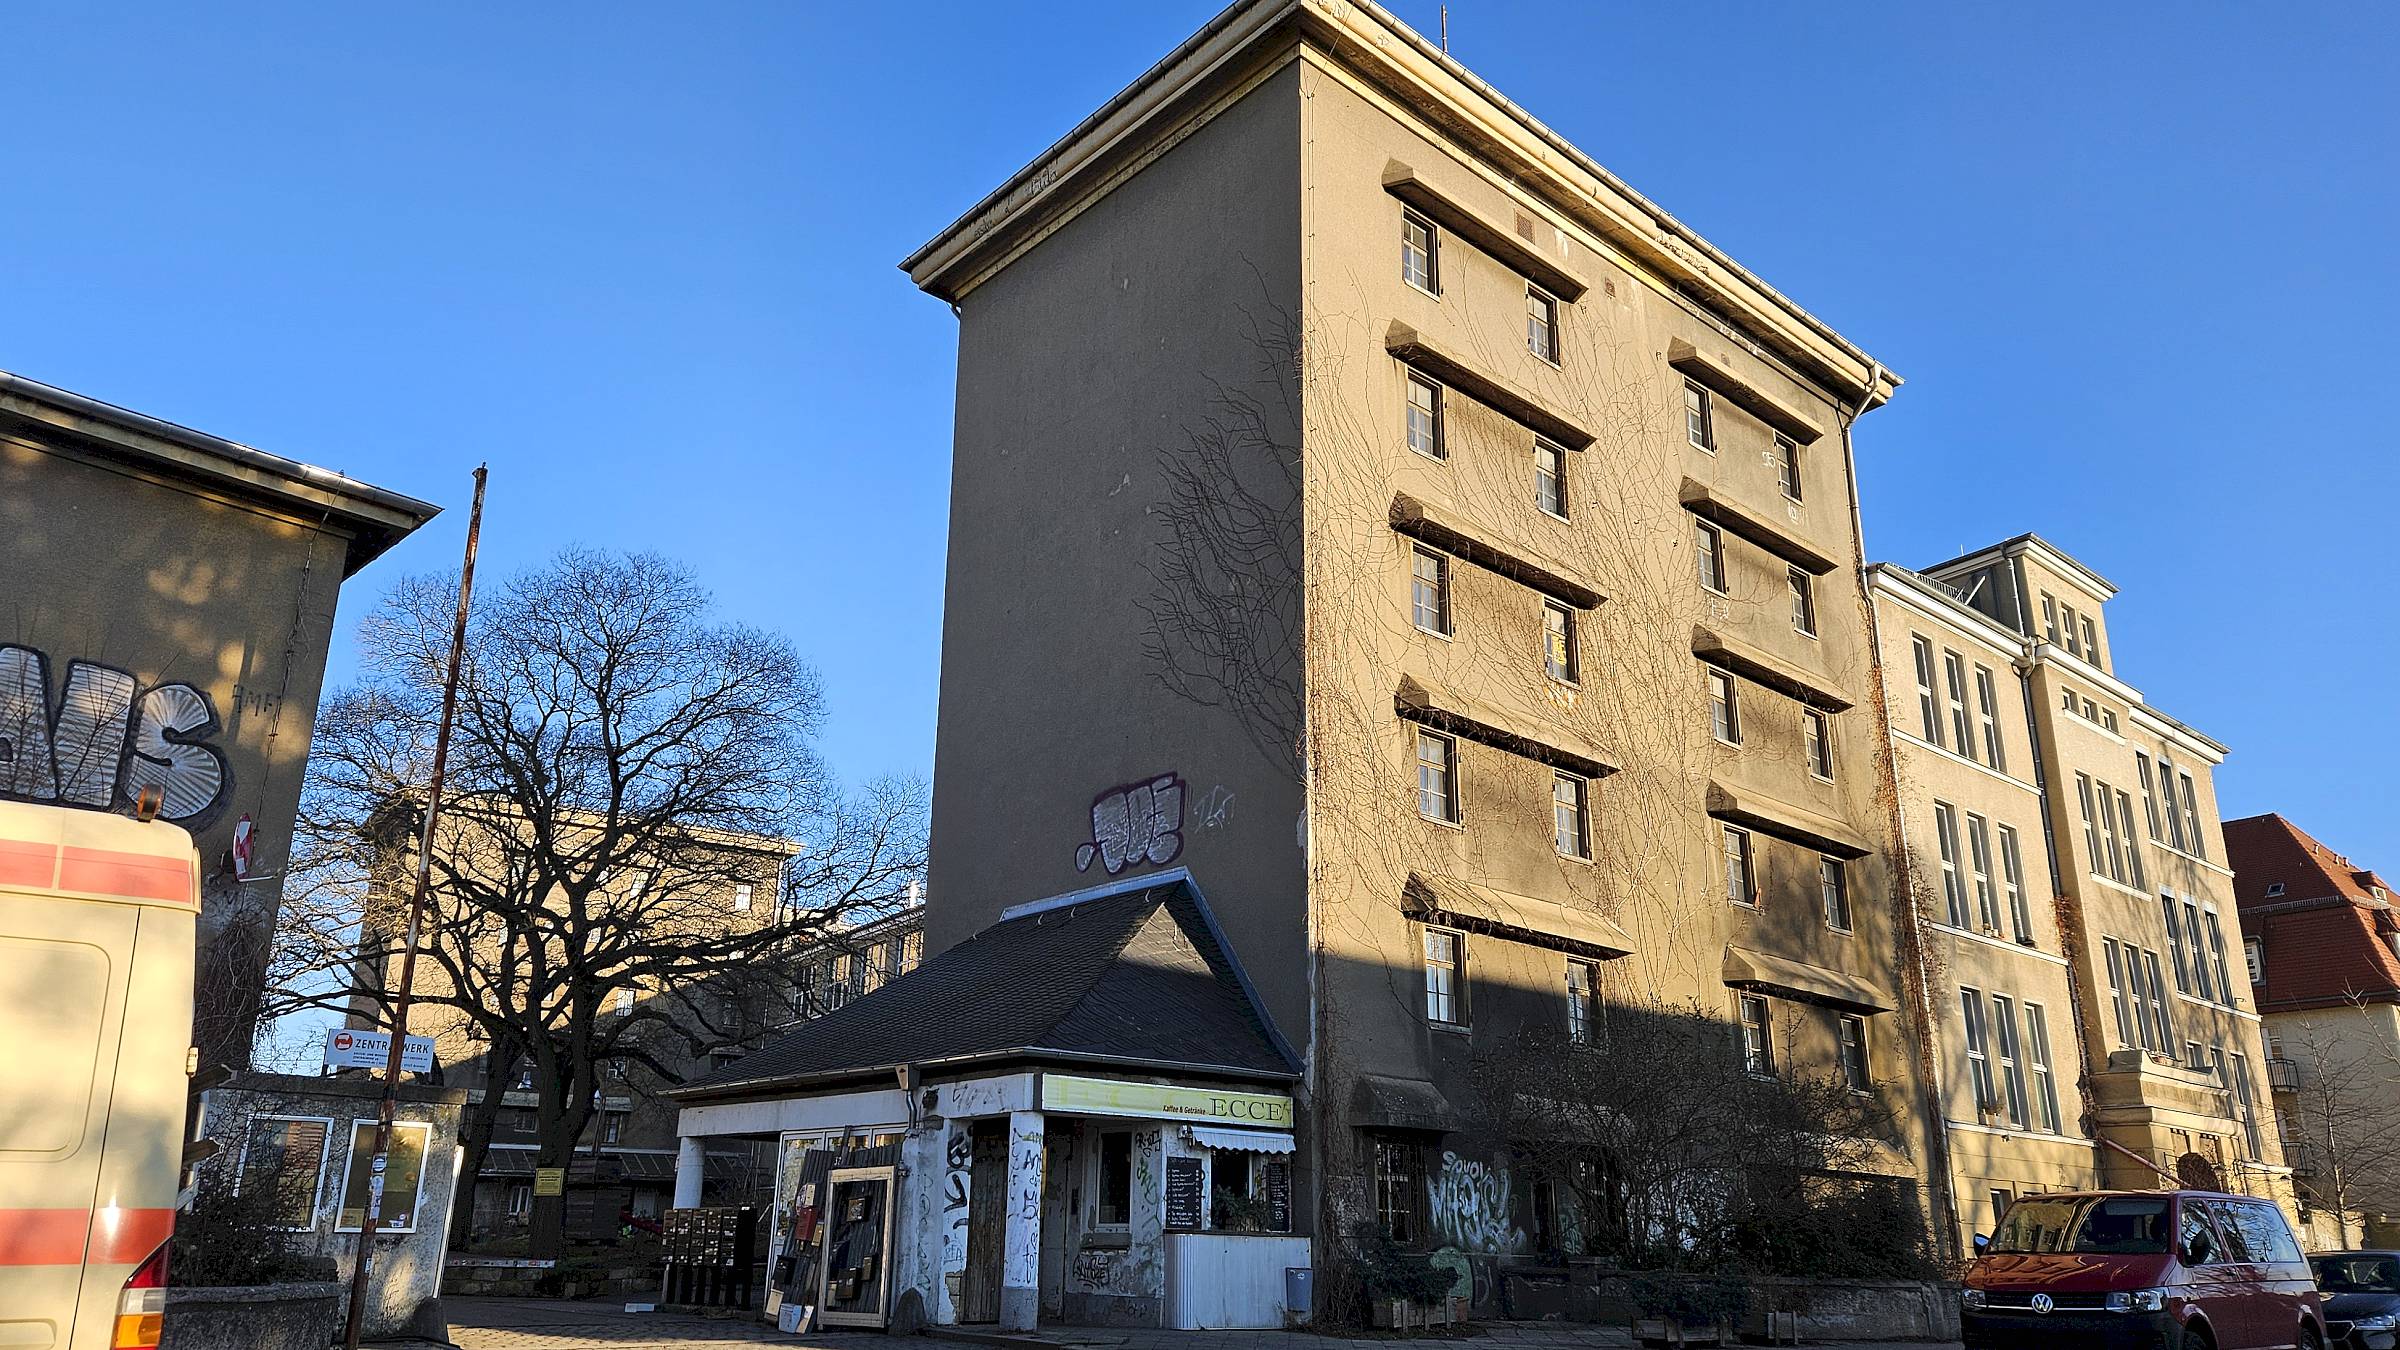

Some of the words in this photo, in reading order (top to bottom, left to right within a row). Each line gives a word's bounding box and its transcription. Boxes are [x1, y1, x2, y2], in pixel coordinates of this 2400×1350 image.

[354, 1038, 430, 1055] ZENTRWERK
[1162, 1104, 1179, 1114] Kaffee
[1179, 1106, 1183, 1114] &
[1184, 1106, 1206, 1116] Getränke
[1208, 1098, 1283, 1121] ECCE
